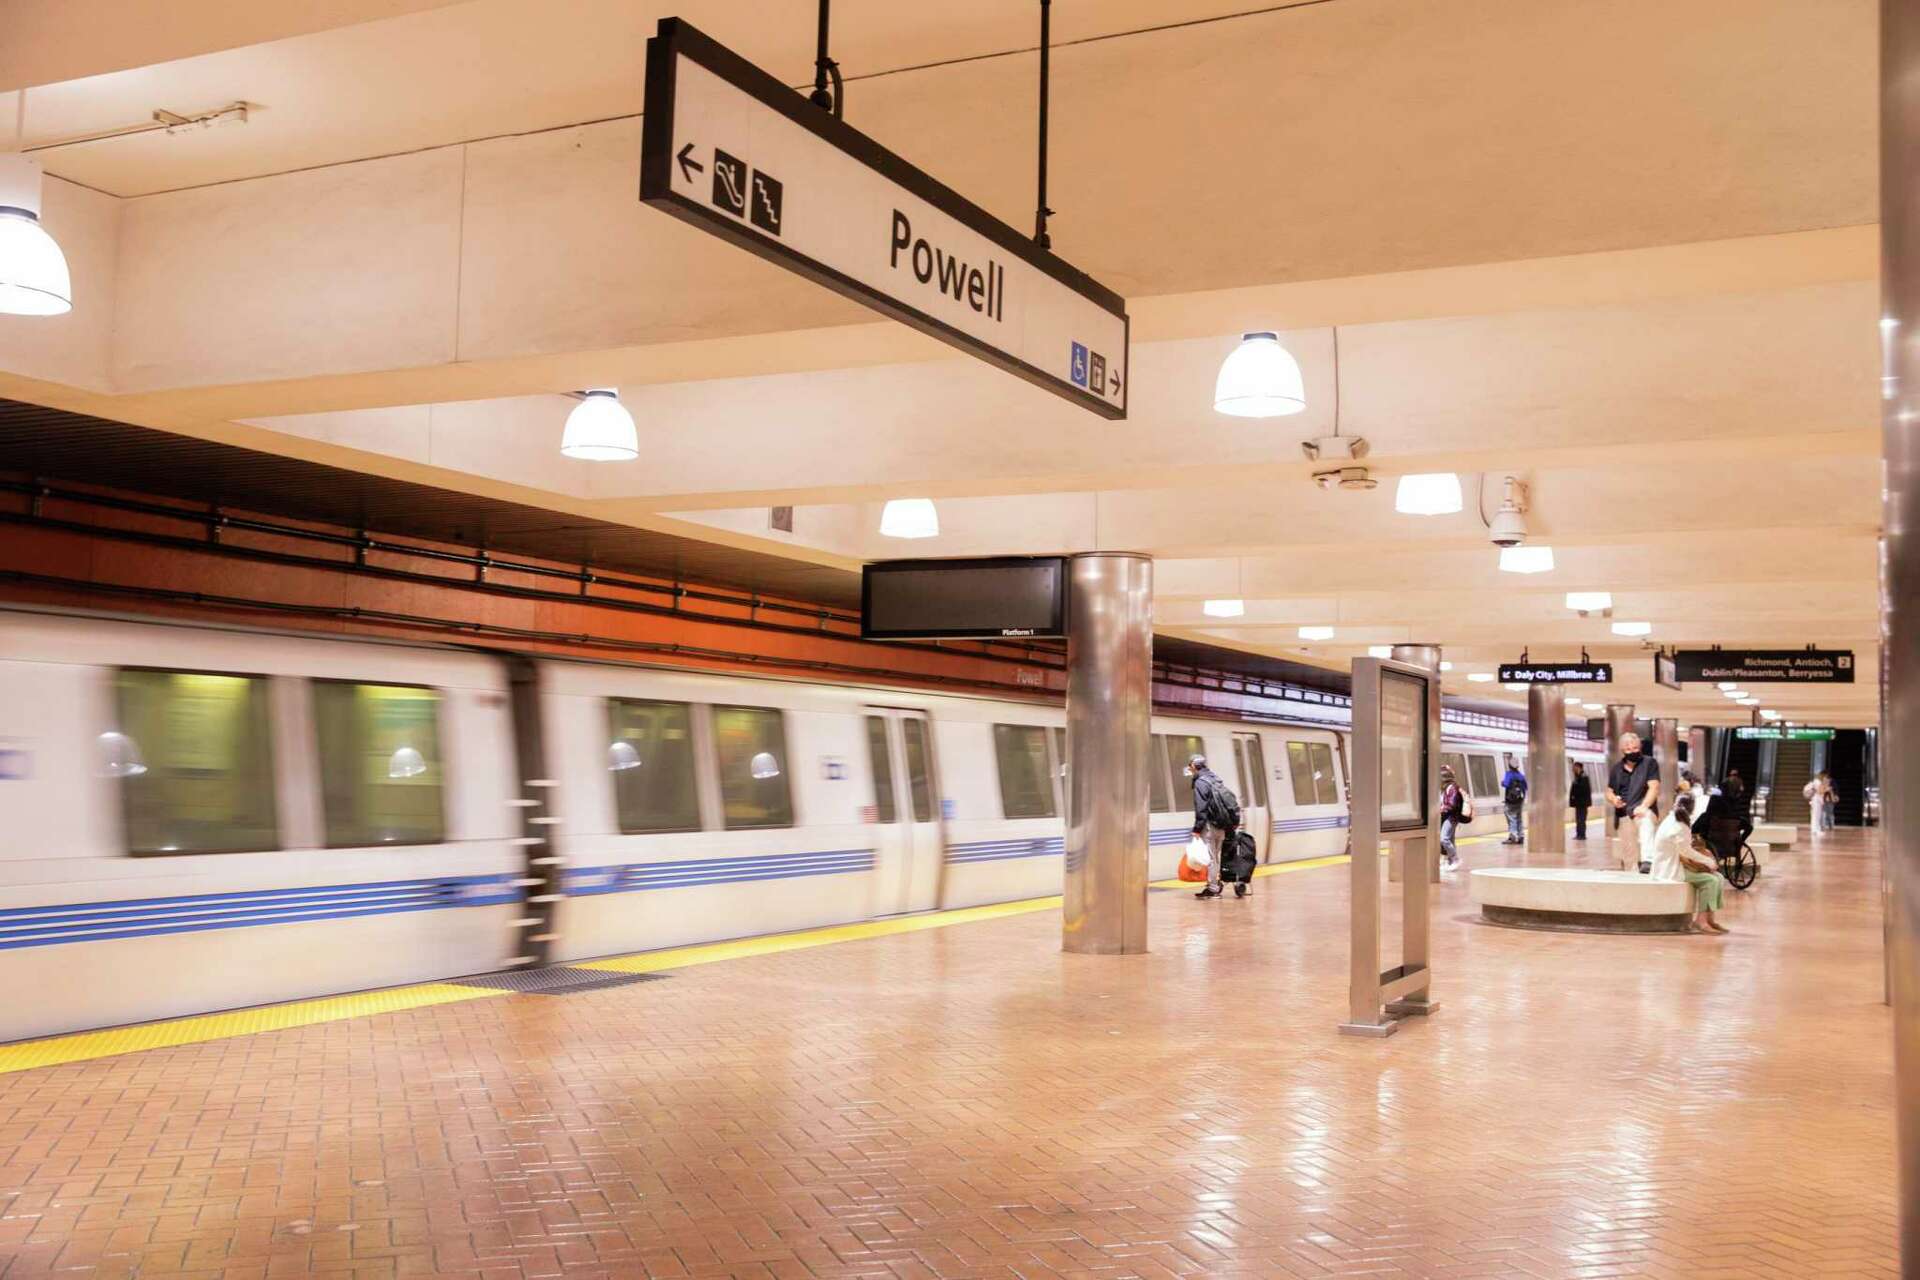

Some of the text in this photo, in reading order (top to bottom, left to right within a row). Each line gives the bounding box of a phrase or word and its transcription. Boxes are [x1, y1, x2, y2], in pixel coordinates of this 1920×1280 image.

[890, 208, 1003, 322] Powell
[1744, 658, 1833, 668] Richmond, Antioch,
[1515, 670, 1592, 680] Daly City, Millbrae
[1702, 668, 1833, 679] Dublin/Pleasanton, Berryessa
